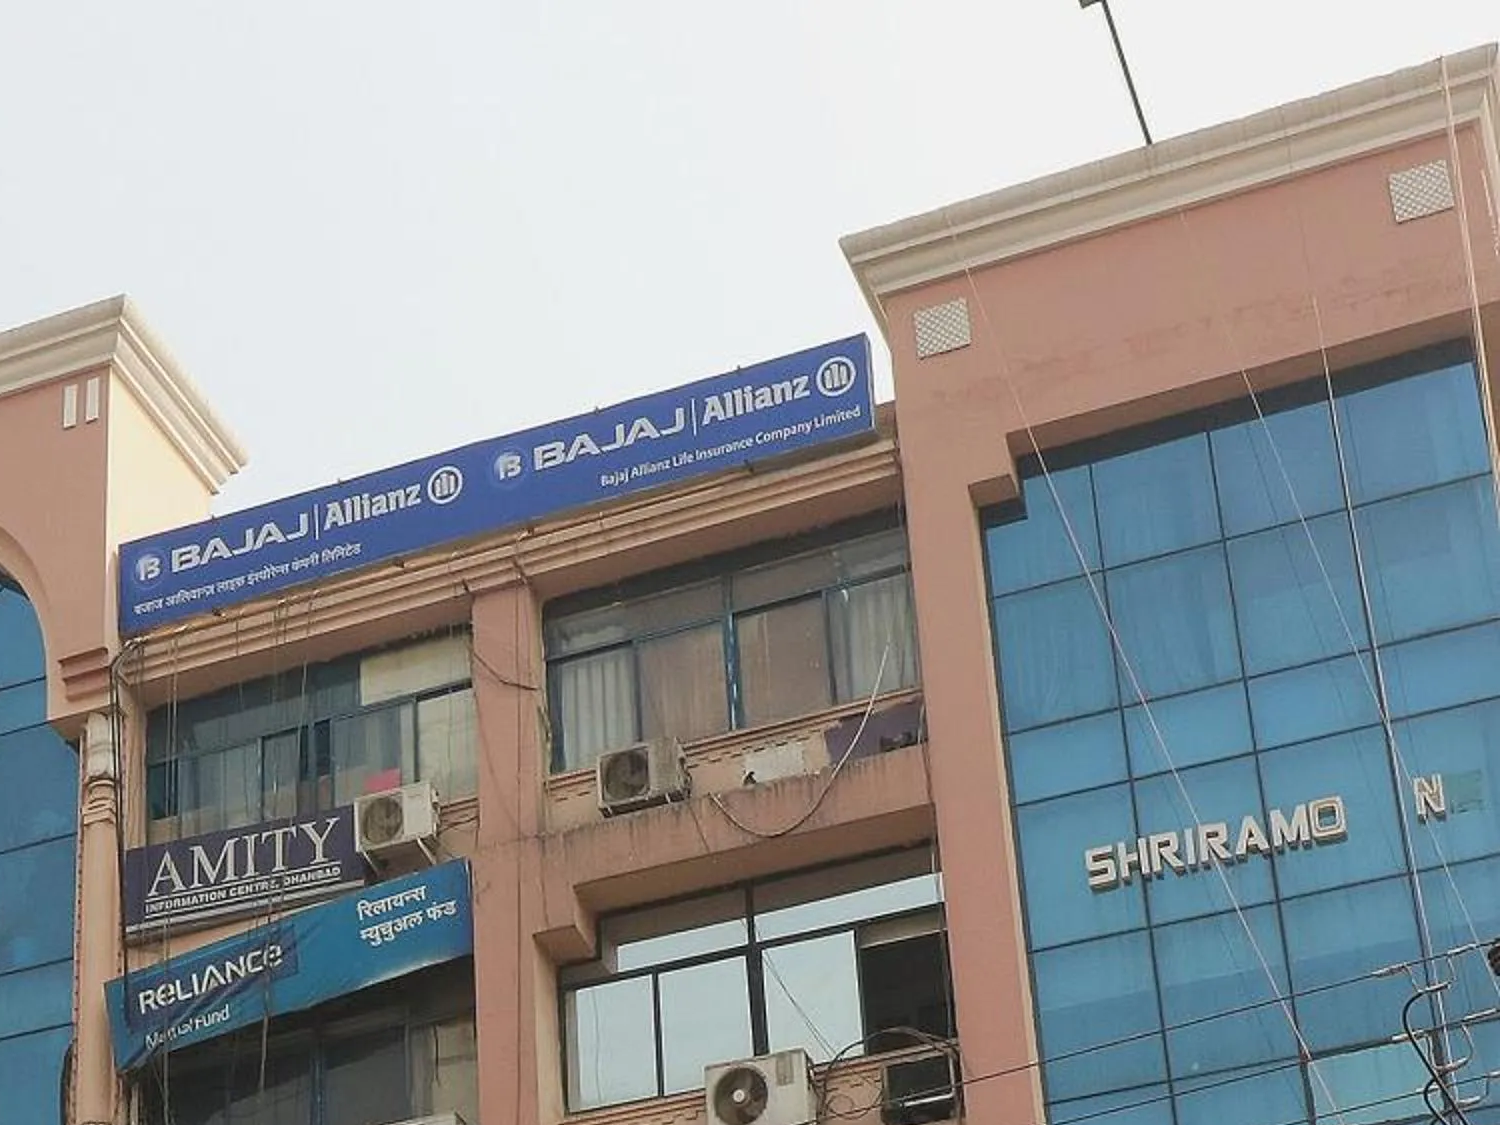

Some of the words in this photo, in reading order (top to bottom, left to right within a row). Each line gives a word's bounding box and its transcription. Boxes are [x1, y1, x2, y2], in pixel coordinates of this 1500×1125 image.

[534, 407, 685, 471] BAJAJ
[703, 374, 810, 425] Allianz
[601, 465, 630, 488] Bajaj
[631, 457, 671, 479] Allianz
[672, 450, 694, 469] Life
[696, 438, 753, 462] Insurance
[755, 422, 813, 446] Company
[814, 405, 861, 429] Limited
[171, 513, 309, 572] BAJAJ
[324, 483, 422, 531] Allianz
[147, 817, 340, 897] AMITY
[145, 889, 227, 914] INFORMATION
[284, 866, 341, 886] DHANBAD
[357, 885, 426, 920] रिलायन्स
[426, 900, 457, 921] फंड
[195, 1003, 230, 1029] Fund
